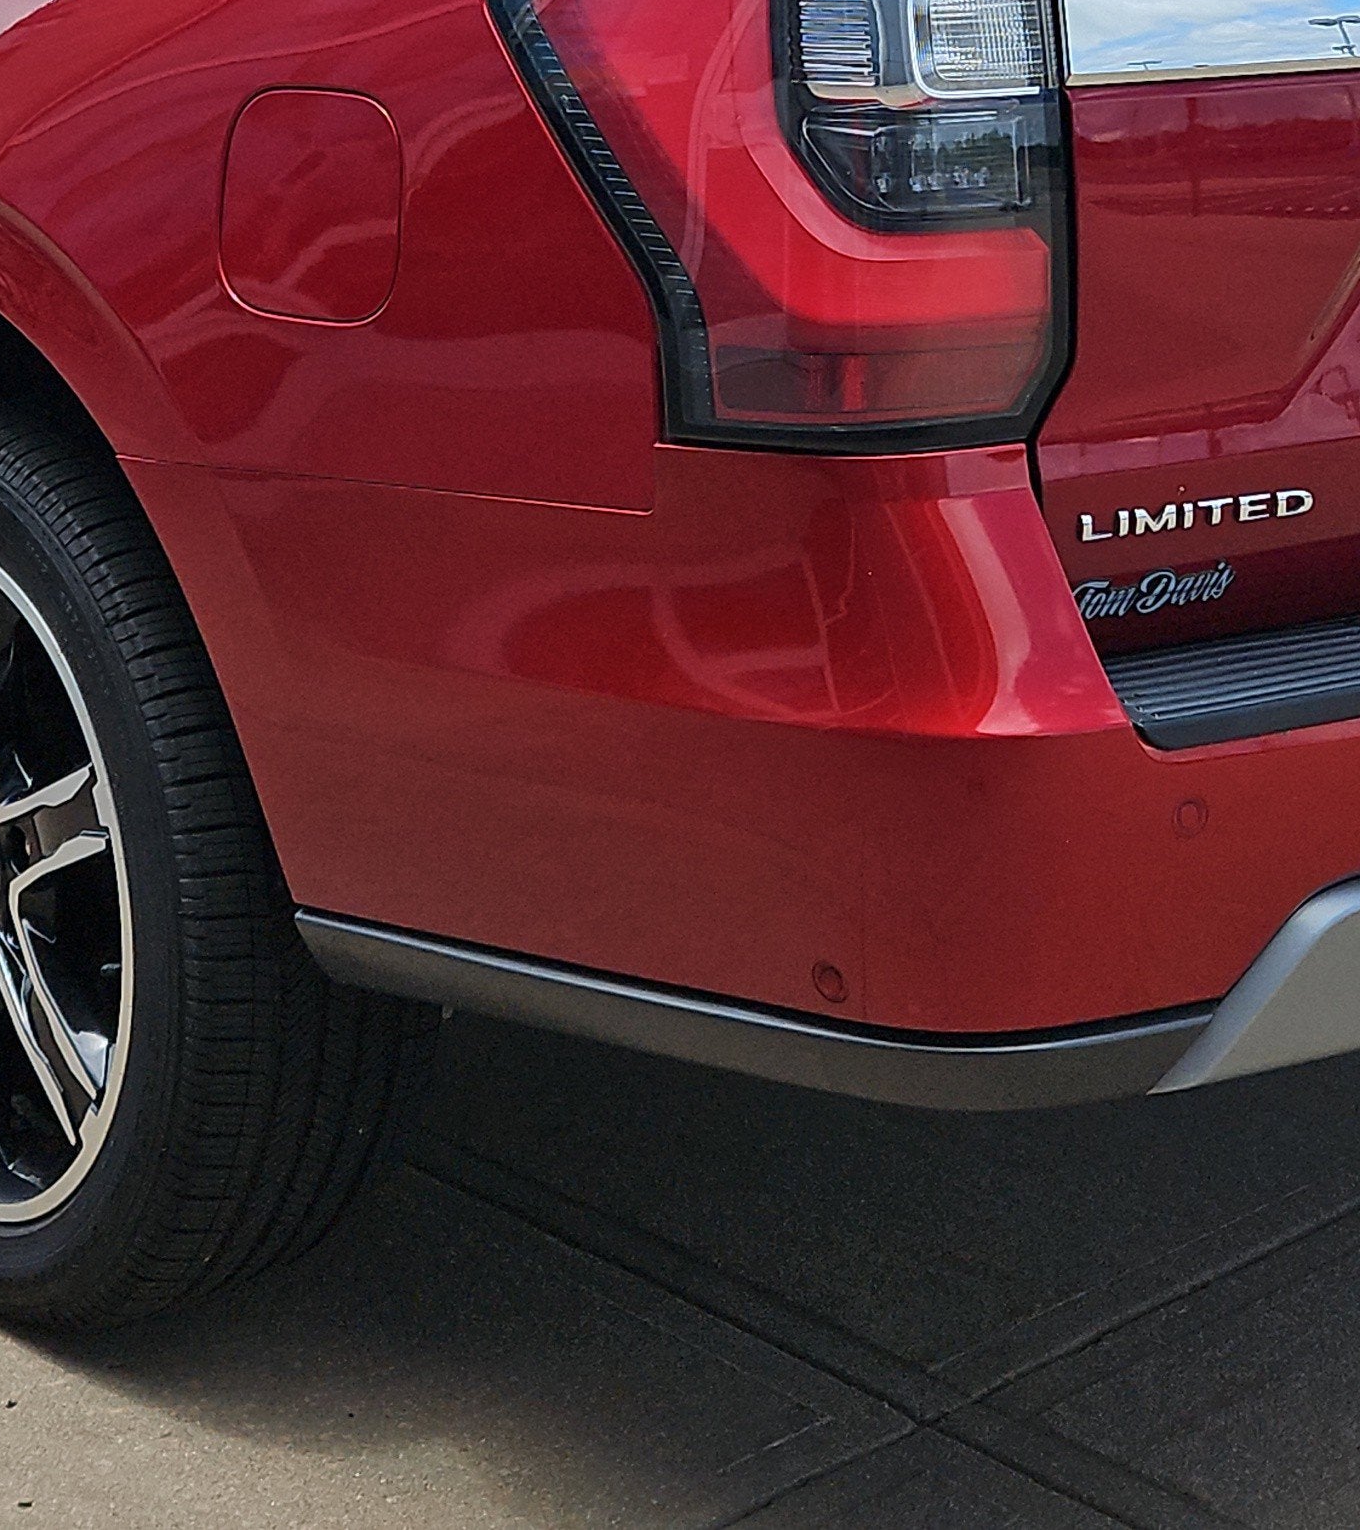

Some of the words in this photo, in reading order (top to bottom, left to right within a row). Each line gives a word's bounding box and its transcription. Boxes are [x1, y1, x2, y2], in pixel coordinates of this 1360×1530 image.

[1078, 489, 1316, 543] LIMITED
[1072, 580, 1136, 620] Tom
[1136, 561, 1234, 614] Davis
